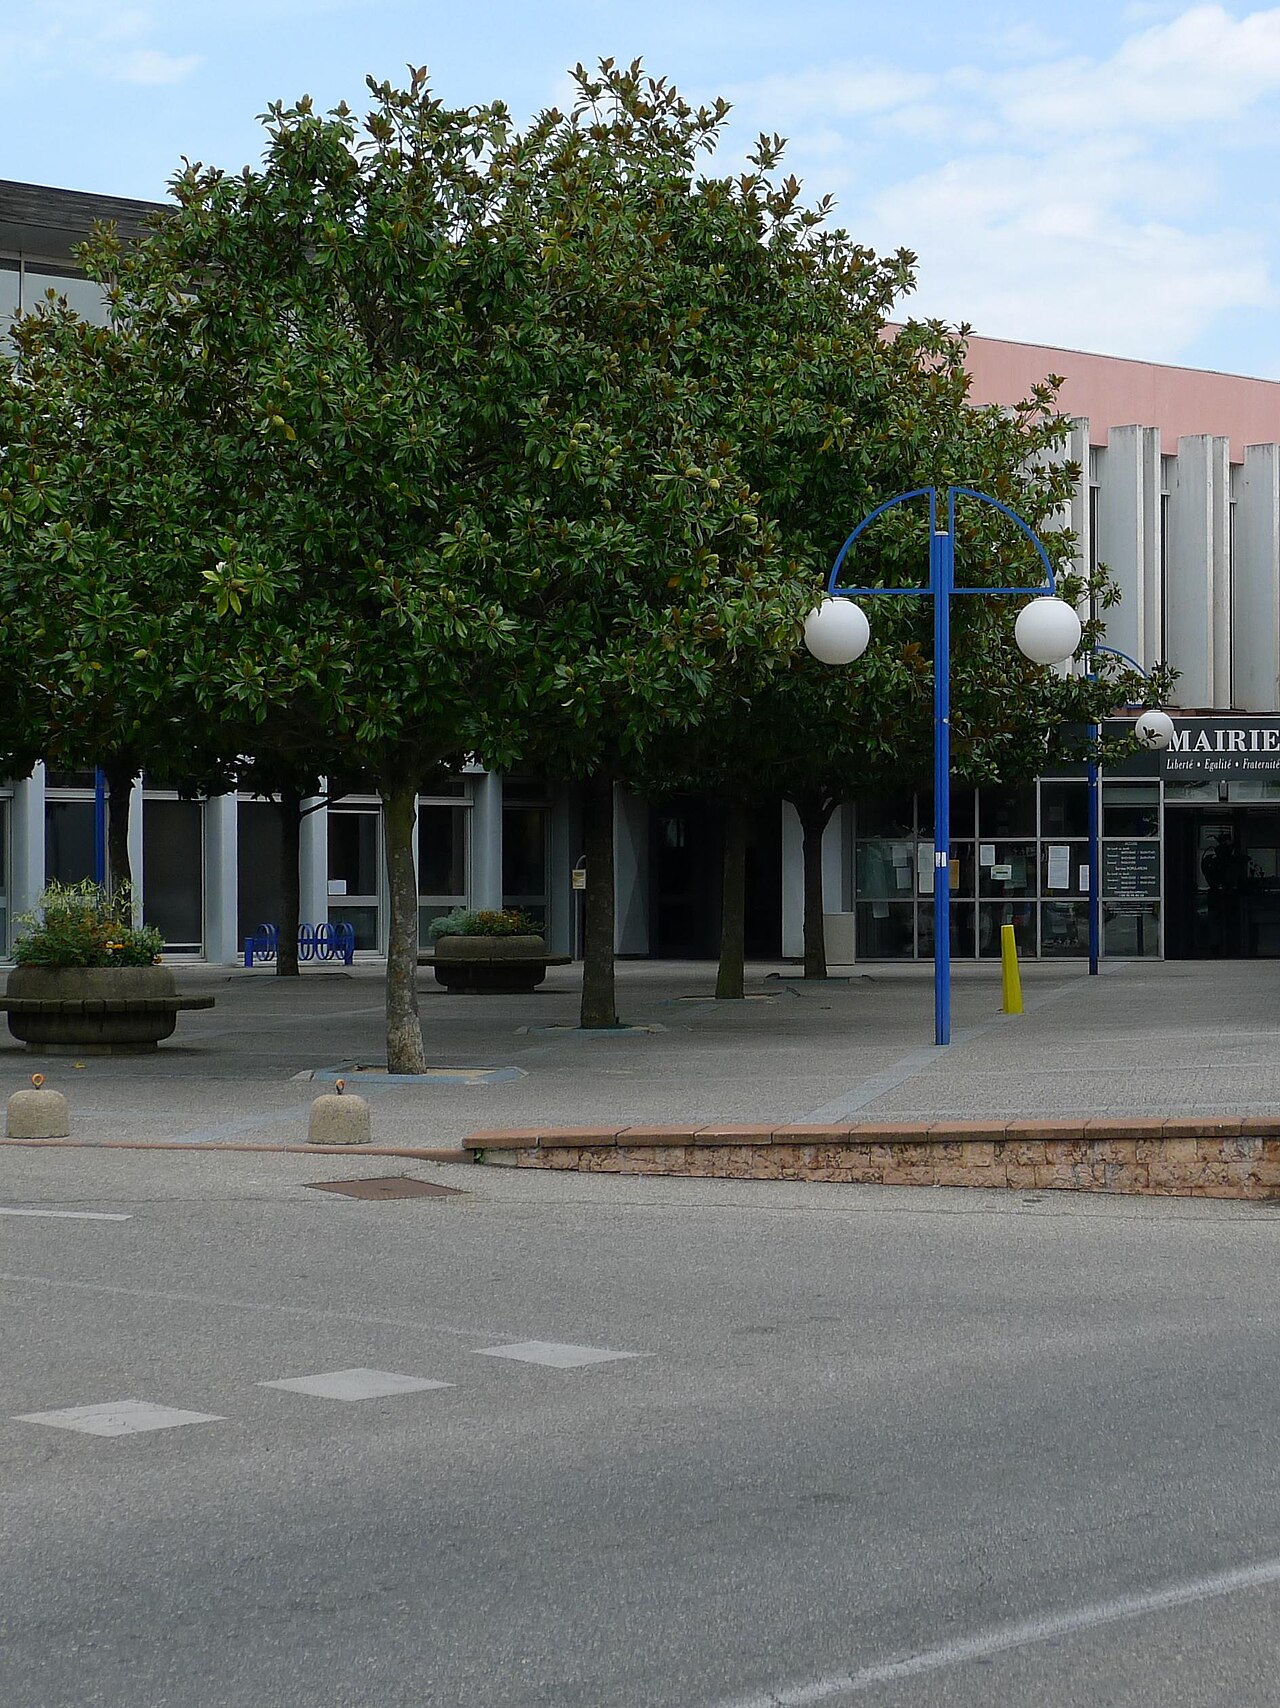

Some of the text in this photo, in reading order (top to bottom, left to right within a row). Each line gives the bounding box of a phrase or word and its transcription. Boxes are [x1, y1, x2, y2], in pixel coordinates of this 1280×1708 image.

[1166, 729, 1280, 752] MAIRIE
[1166, 757, 1280, 772] Liberté Egalité Fraternité
